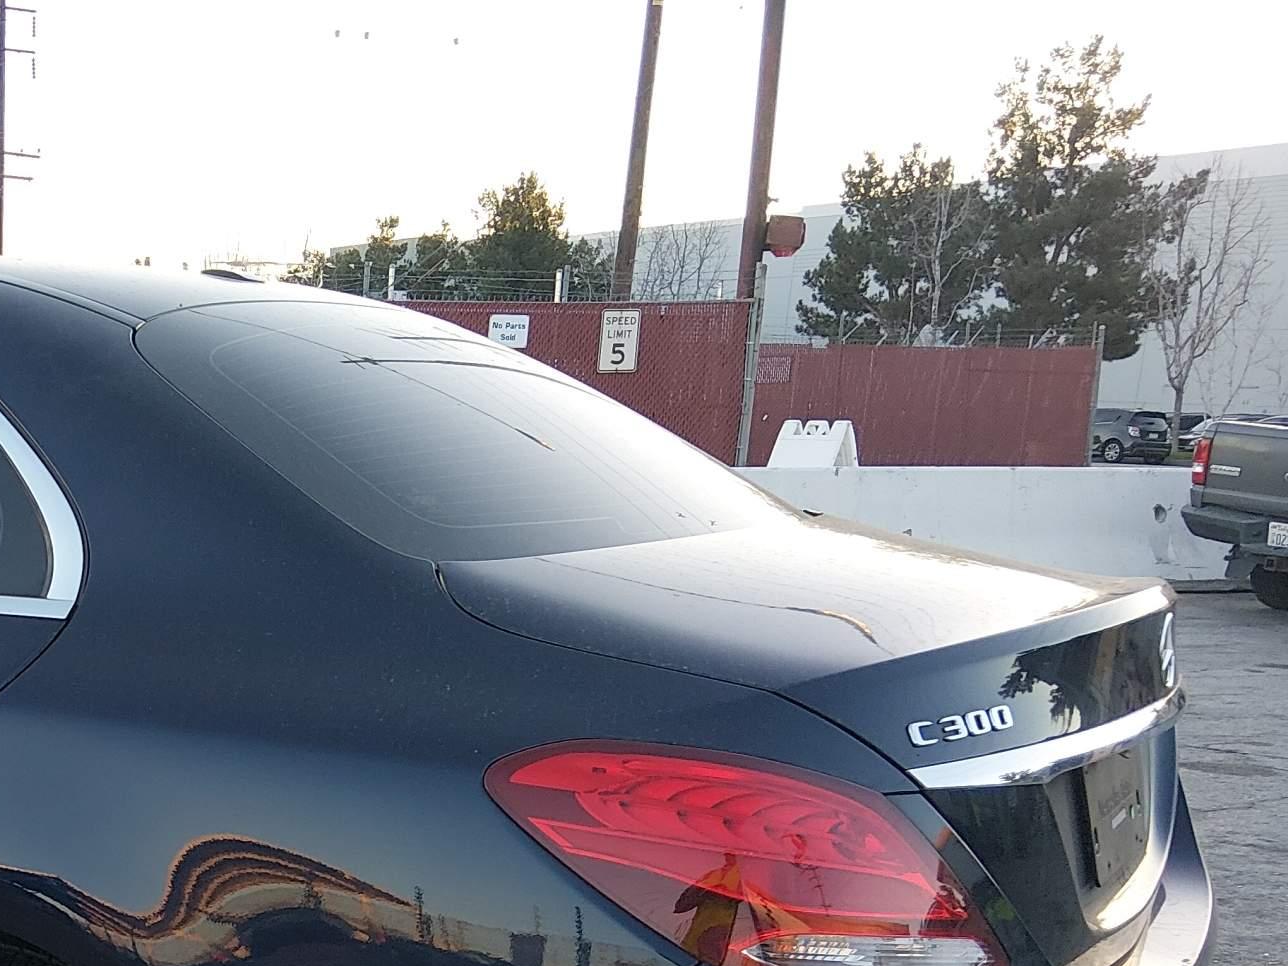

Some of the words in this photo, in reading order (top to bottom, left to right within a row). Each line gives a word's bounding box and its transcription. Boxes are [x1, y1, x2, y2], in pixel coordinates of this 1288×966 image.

[492, 321, 503, 329] No
[505, 322, 526, 330] Parts
[605, 316, 637, 326] SPEED
[500, 333, 516, 341] Sold
[607, 329, 632, 339] LIMIT
[610, 343, 625, 365] 5
